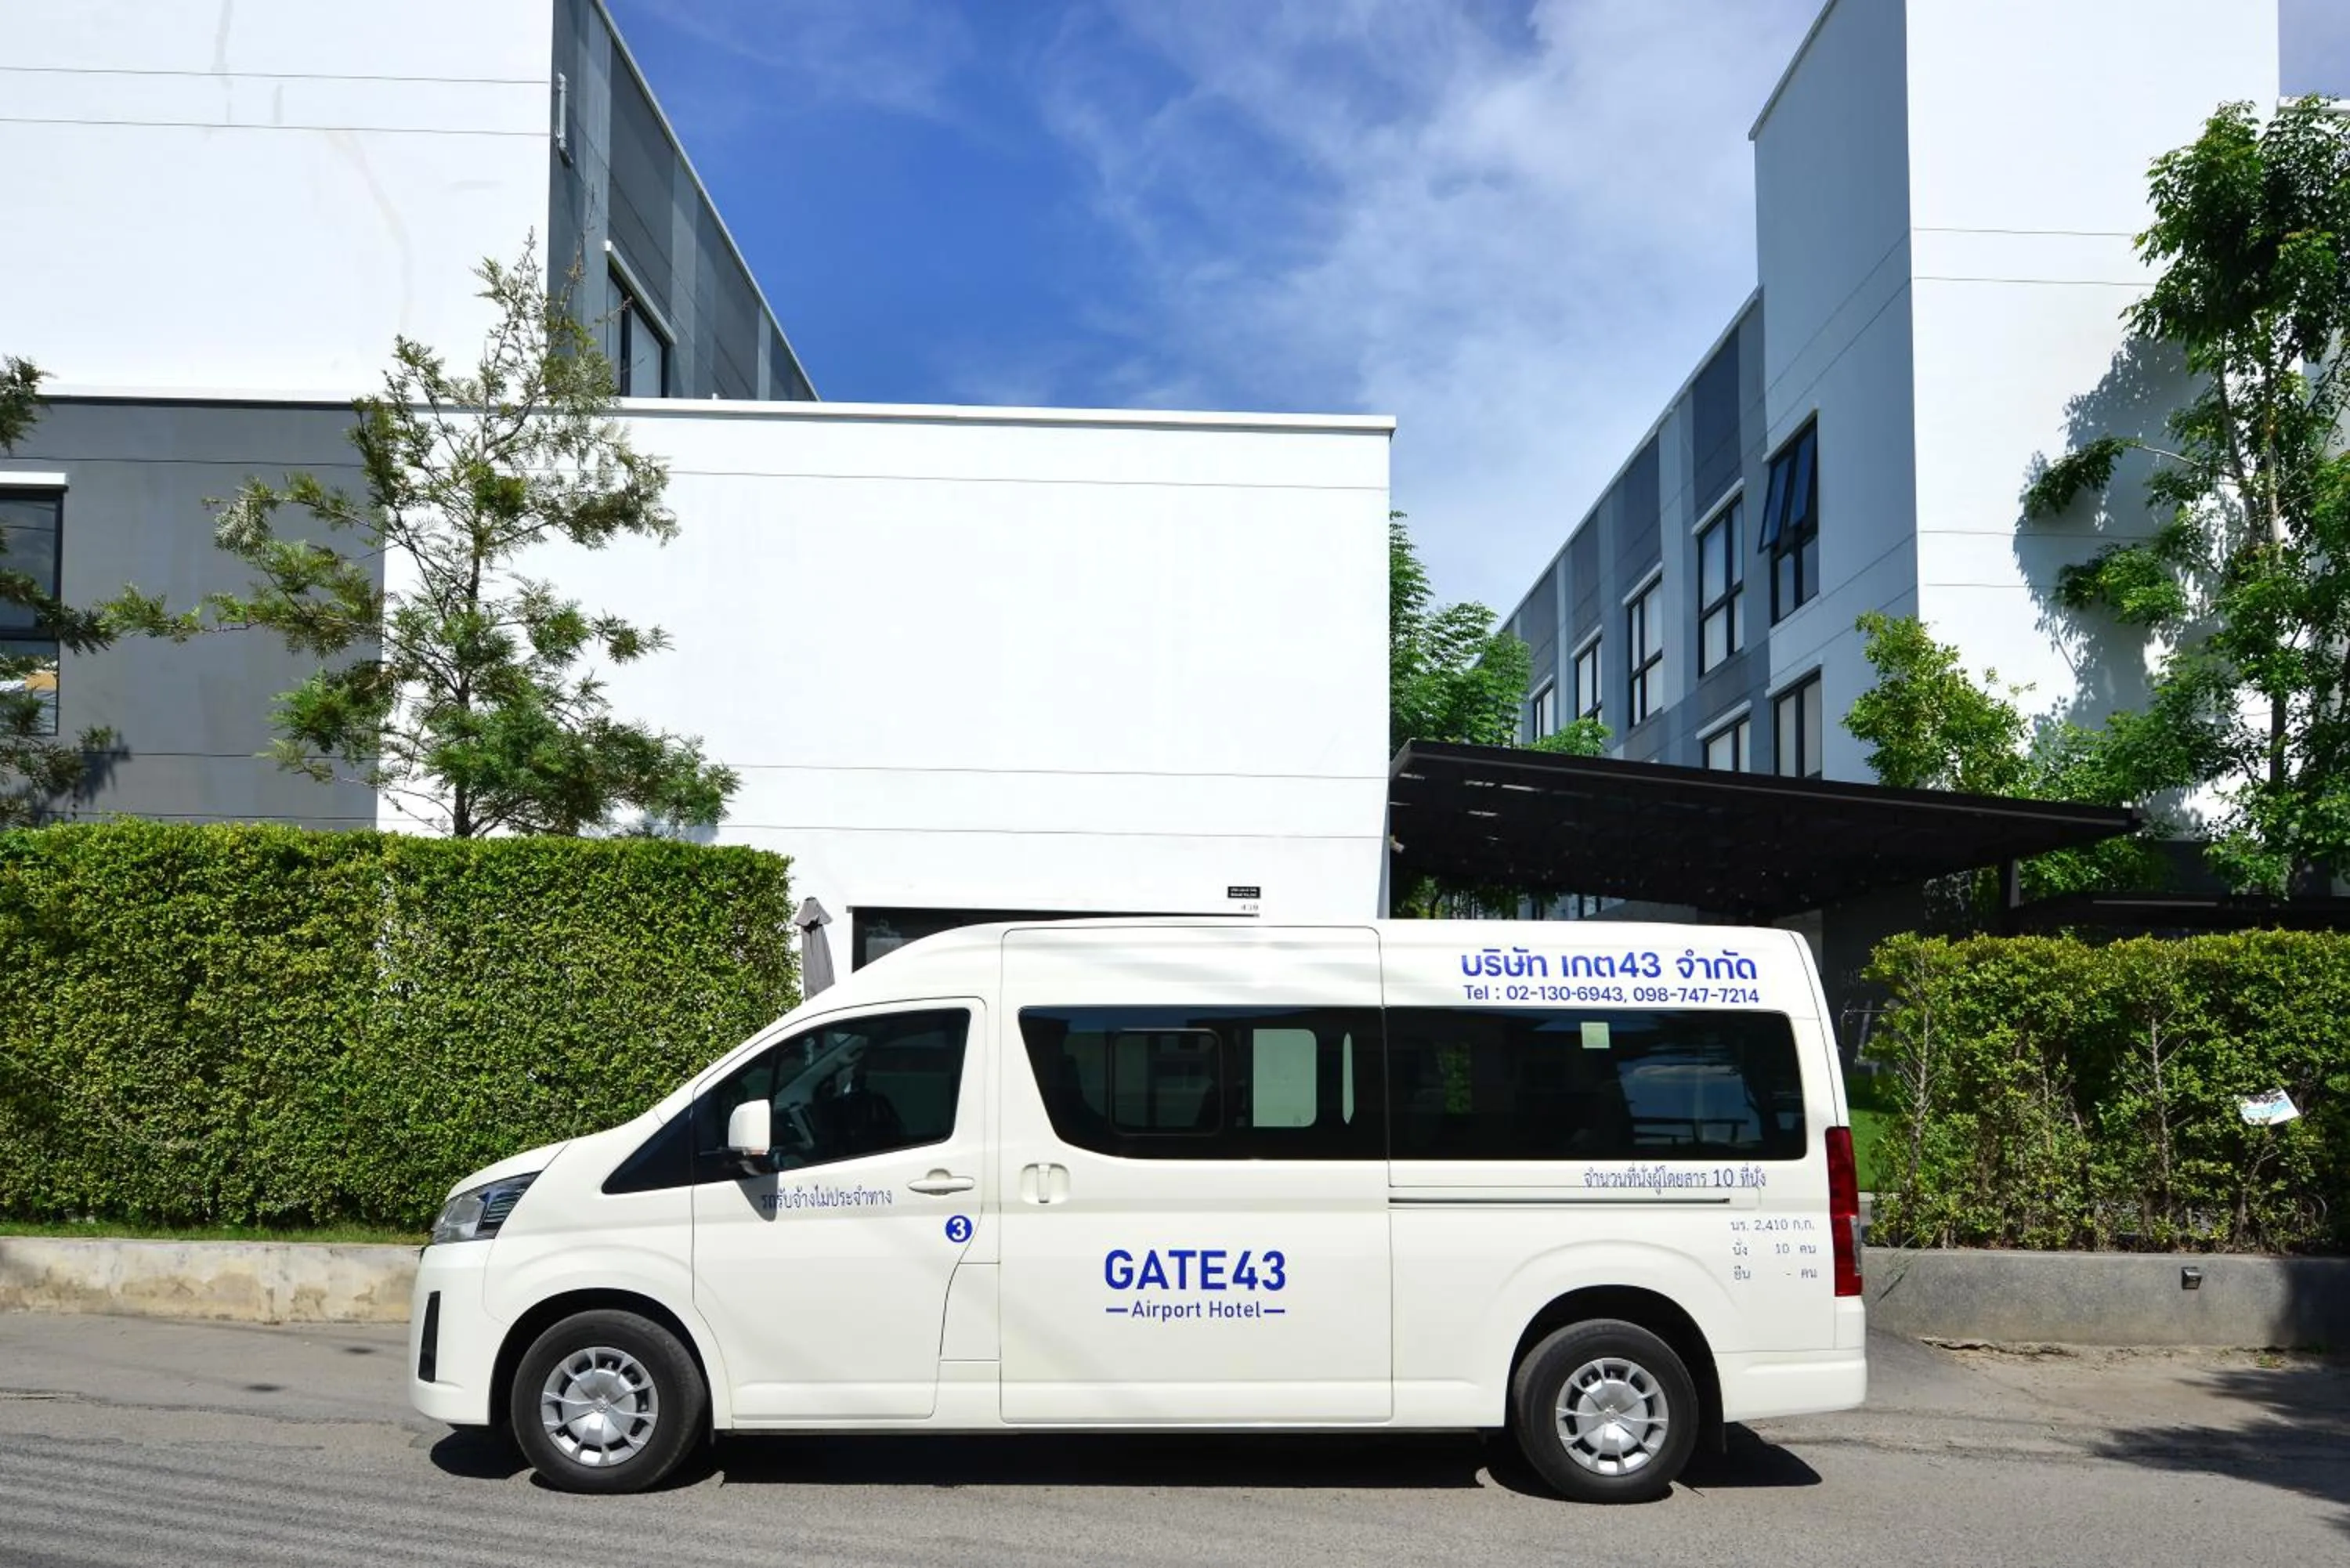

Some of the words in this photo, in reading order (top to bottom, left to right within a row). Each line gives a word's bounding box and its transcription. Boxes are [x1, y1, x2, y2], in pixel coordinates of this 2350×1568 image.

[1461, 946, 1548, 977] บริษัท
[1561, 952, 1661, 978] เกต43
[1676, 948, 1757, 980] จำกัด
[1463, 985, 1489, 1000] Tel
[1506, 985, 1628, 1003] 02-130-6943,
[1632, 986, 1760, 1003] 098-747-7214
[1583, 1164, 1707, 1194] จำนวนที่นั่งผู้โดยสาร
[1713, 1168, 1734, 1187] 10
[1740, 1164, 1766, 1189] ที่นั่ง
[761, 1184, 892, 1209] รถรับจ้างไม่ประจำทาง
[1775, 1243, 1790, 1254] 10
[1799, 1245, 1817, 1254] คน
[1104, 1249, 1286, 1292] GATE43
[1801, 1268, 1817, 1279] คน
[1131, 1300, 1202, 1322] Airport
[1209, 1300, 1261, 1318] Hotel
